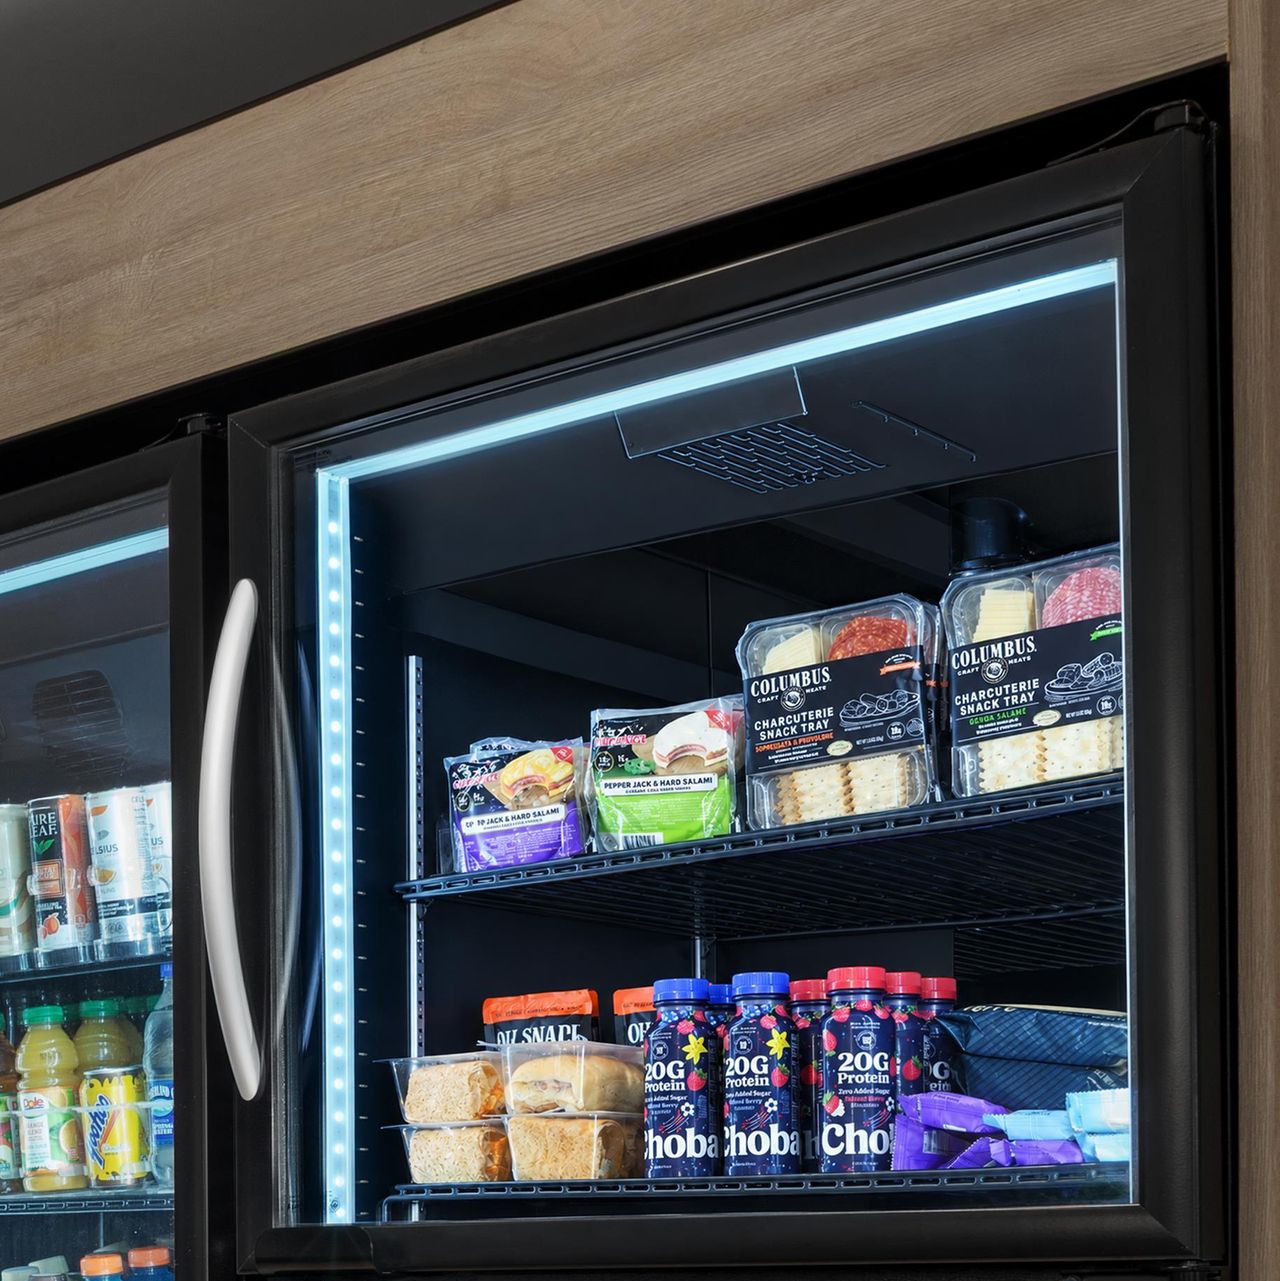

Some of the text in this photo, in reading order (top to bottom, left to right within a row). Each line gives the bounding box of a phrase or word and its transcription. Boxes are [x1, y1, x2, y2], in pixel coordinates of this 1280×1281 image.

[957, 655, 1031, 676] CRAFT MEATS
[757, 695, 779, 704] CRAFT
[955, 678, 1040, 706] CHARCUTERIE
[960, 692, 1035, 716] SNACK TRAY
[754, 707, 834, 731] CHARCUTERIE
[760, 719, 830, 741] SNACK TRAY
[603, 780, 632, 789] PEPPER
[632, 779, 652, 788] JACK
[659, 778, 681, 787] HARD
[682, 776, 713, 786] SALAMI
[532, 808, 560, 818] SALAMI
[645, 1060, 685, 1080] 20G
[725, 1055, 769, 1075] 20G
[837, 1051, 889, 1072] 20G
[644, 1076, 685, 1092] Protein
[725, 1072, 769, 1088] Protein
[838, 1072, 889, 1085] Protein
